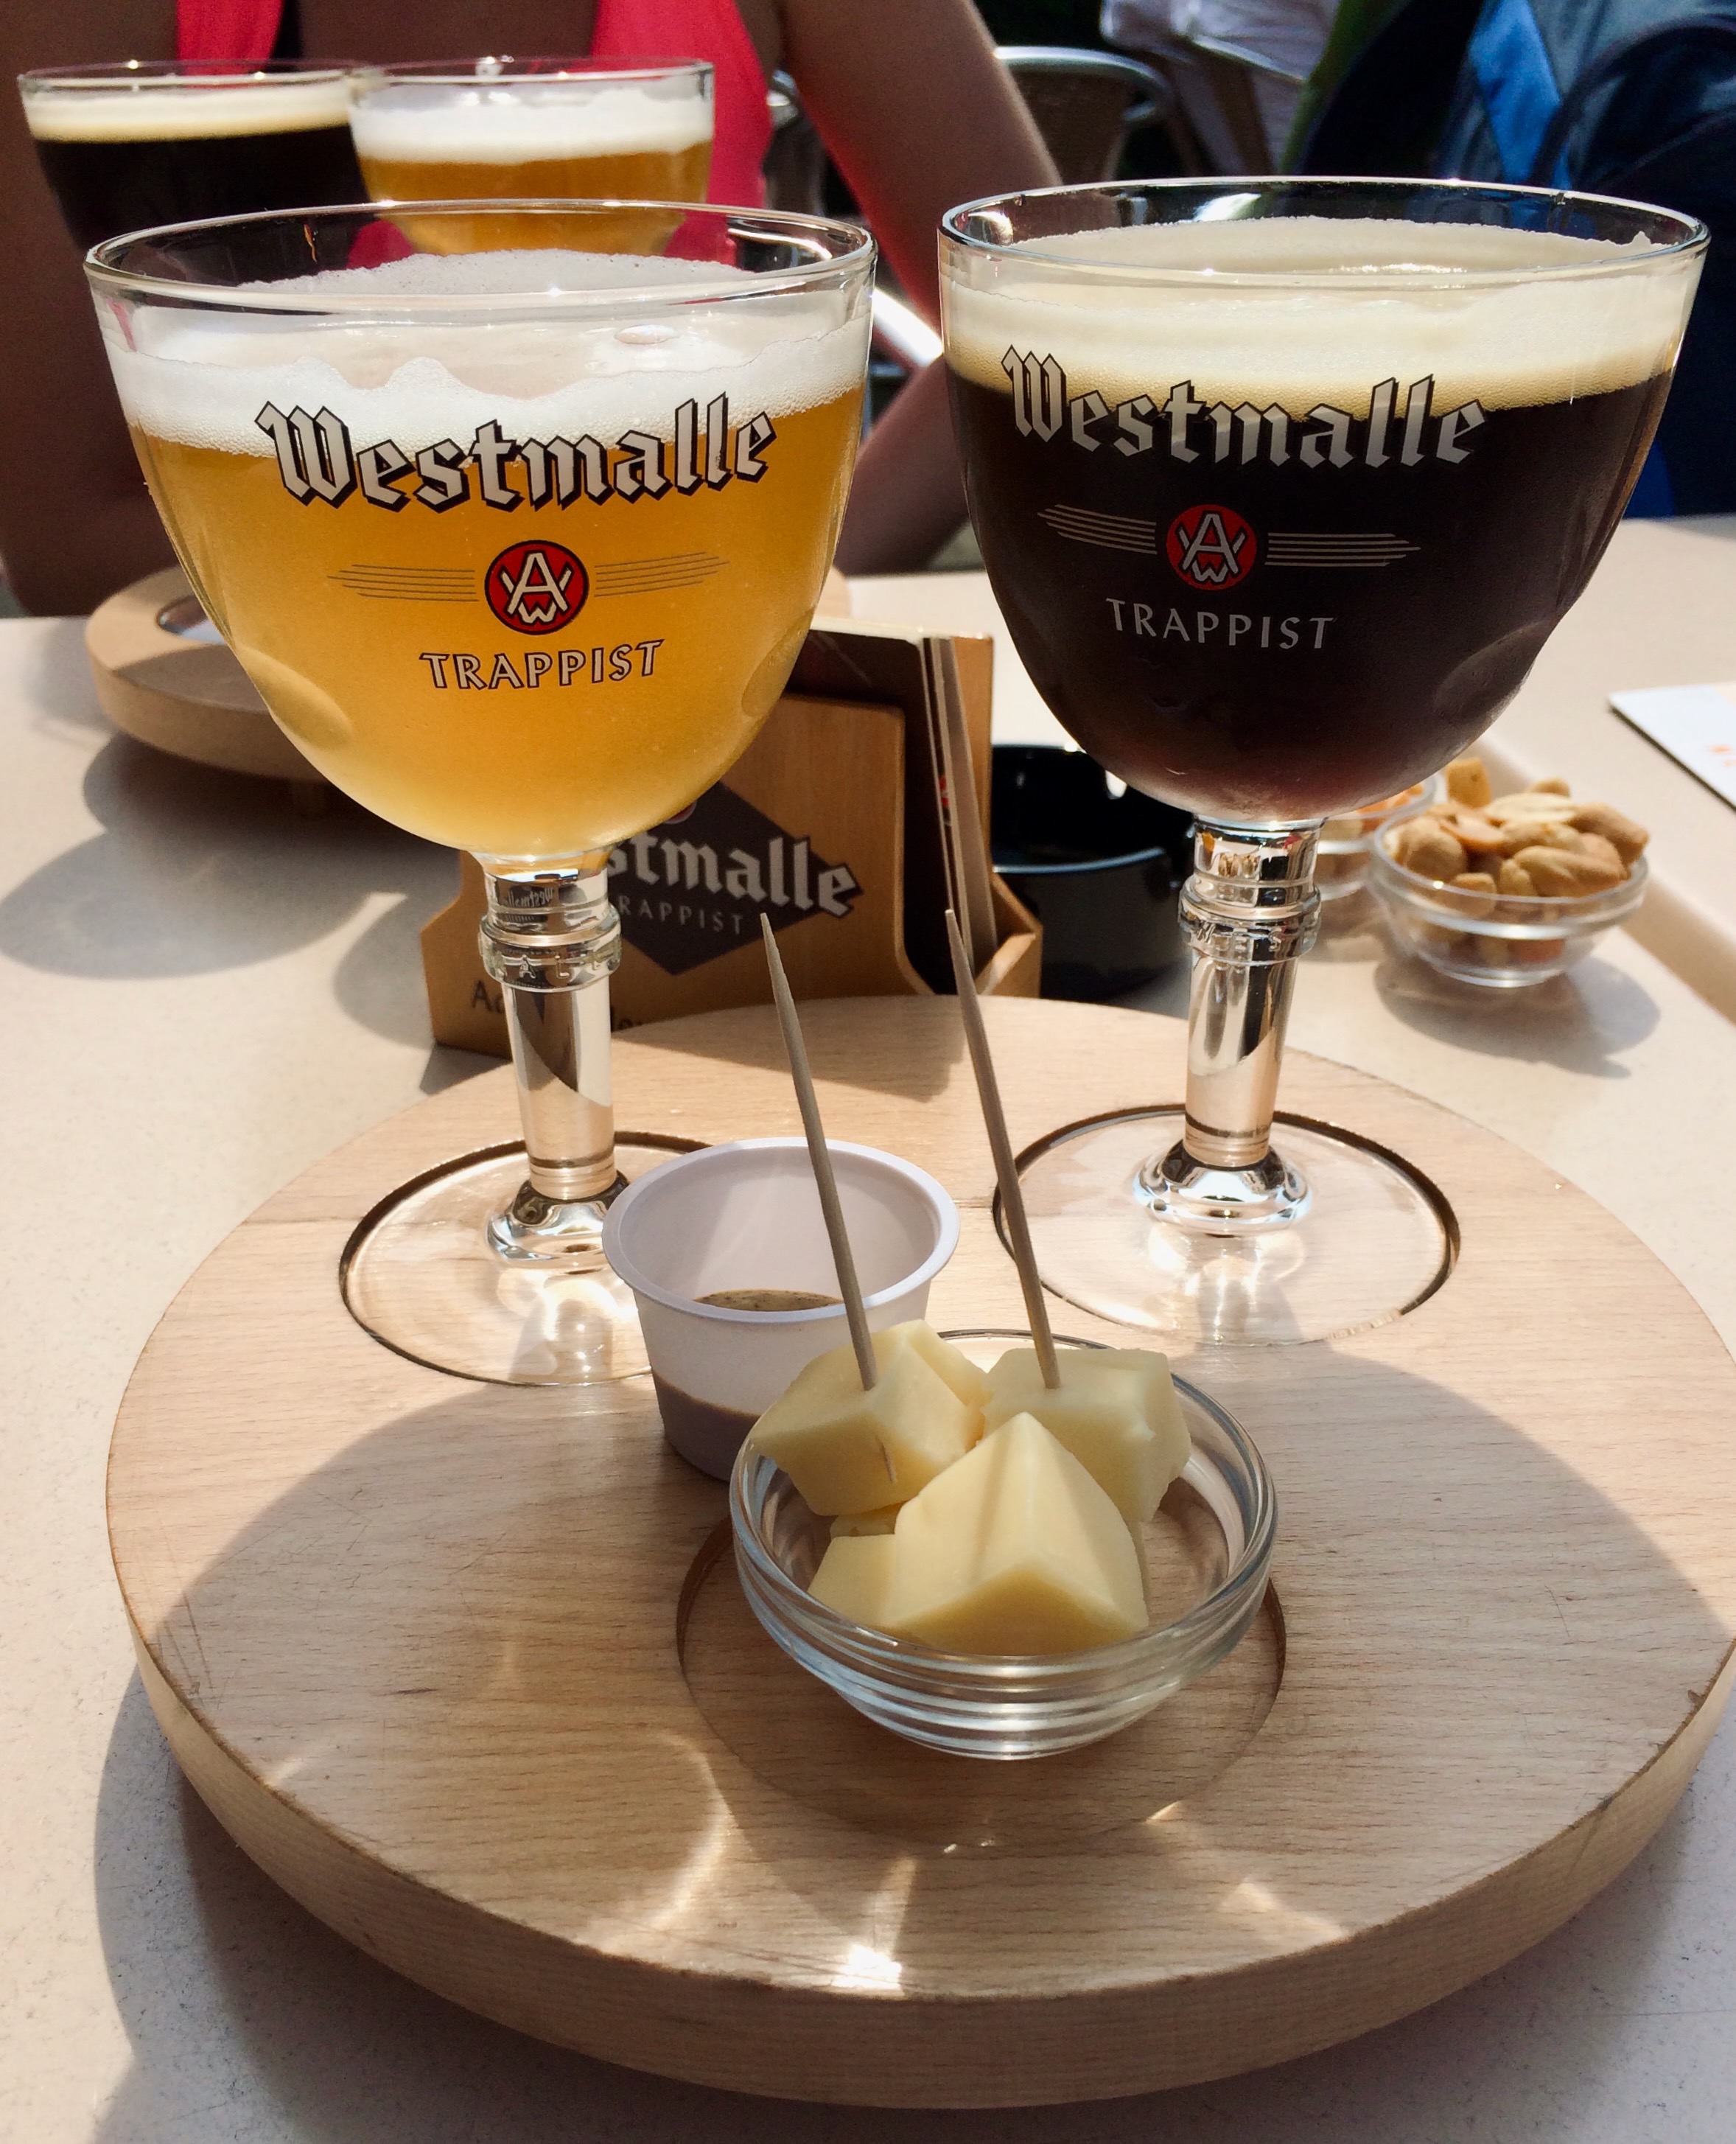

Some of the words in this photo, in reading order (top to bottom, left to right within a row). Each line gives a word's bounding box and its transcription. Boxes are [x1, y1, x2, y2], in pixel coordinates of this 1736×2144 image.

[1001, 344, 1485, 469] Westmalle
[254, 391, 777, 514] Westmalle
[1106, 597, 1334, 649] TRAPPIST
[419, 639, 665, 691] TRAPPIST
[608, 833, 863, 918] stmalle
[619, 895, 743, 935] RAPPIST
